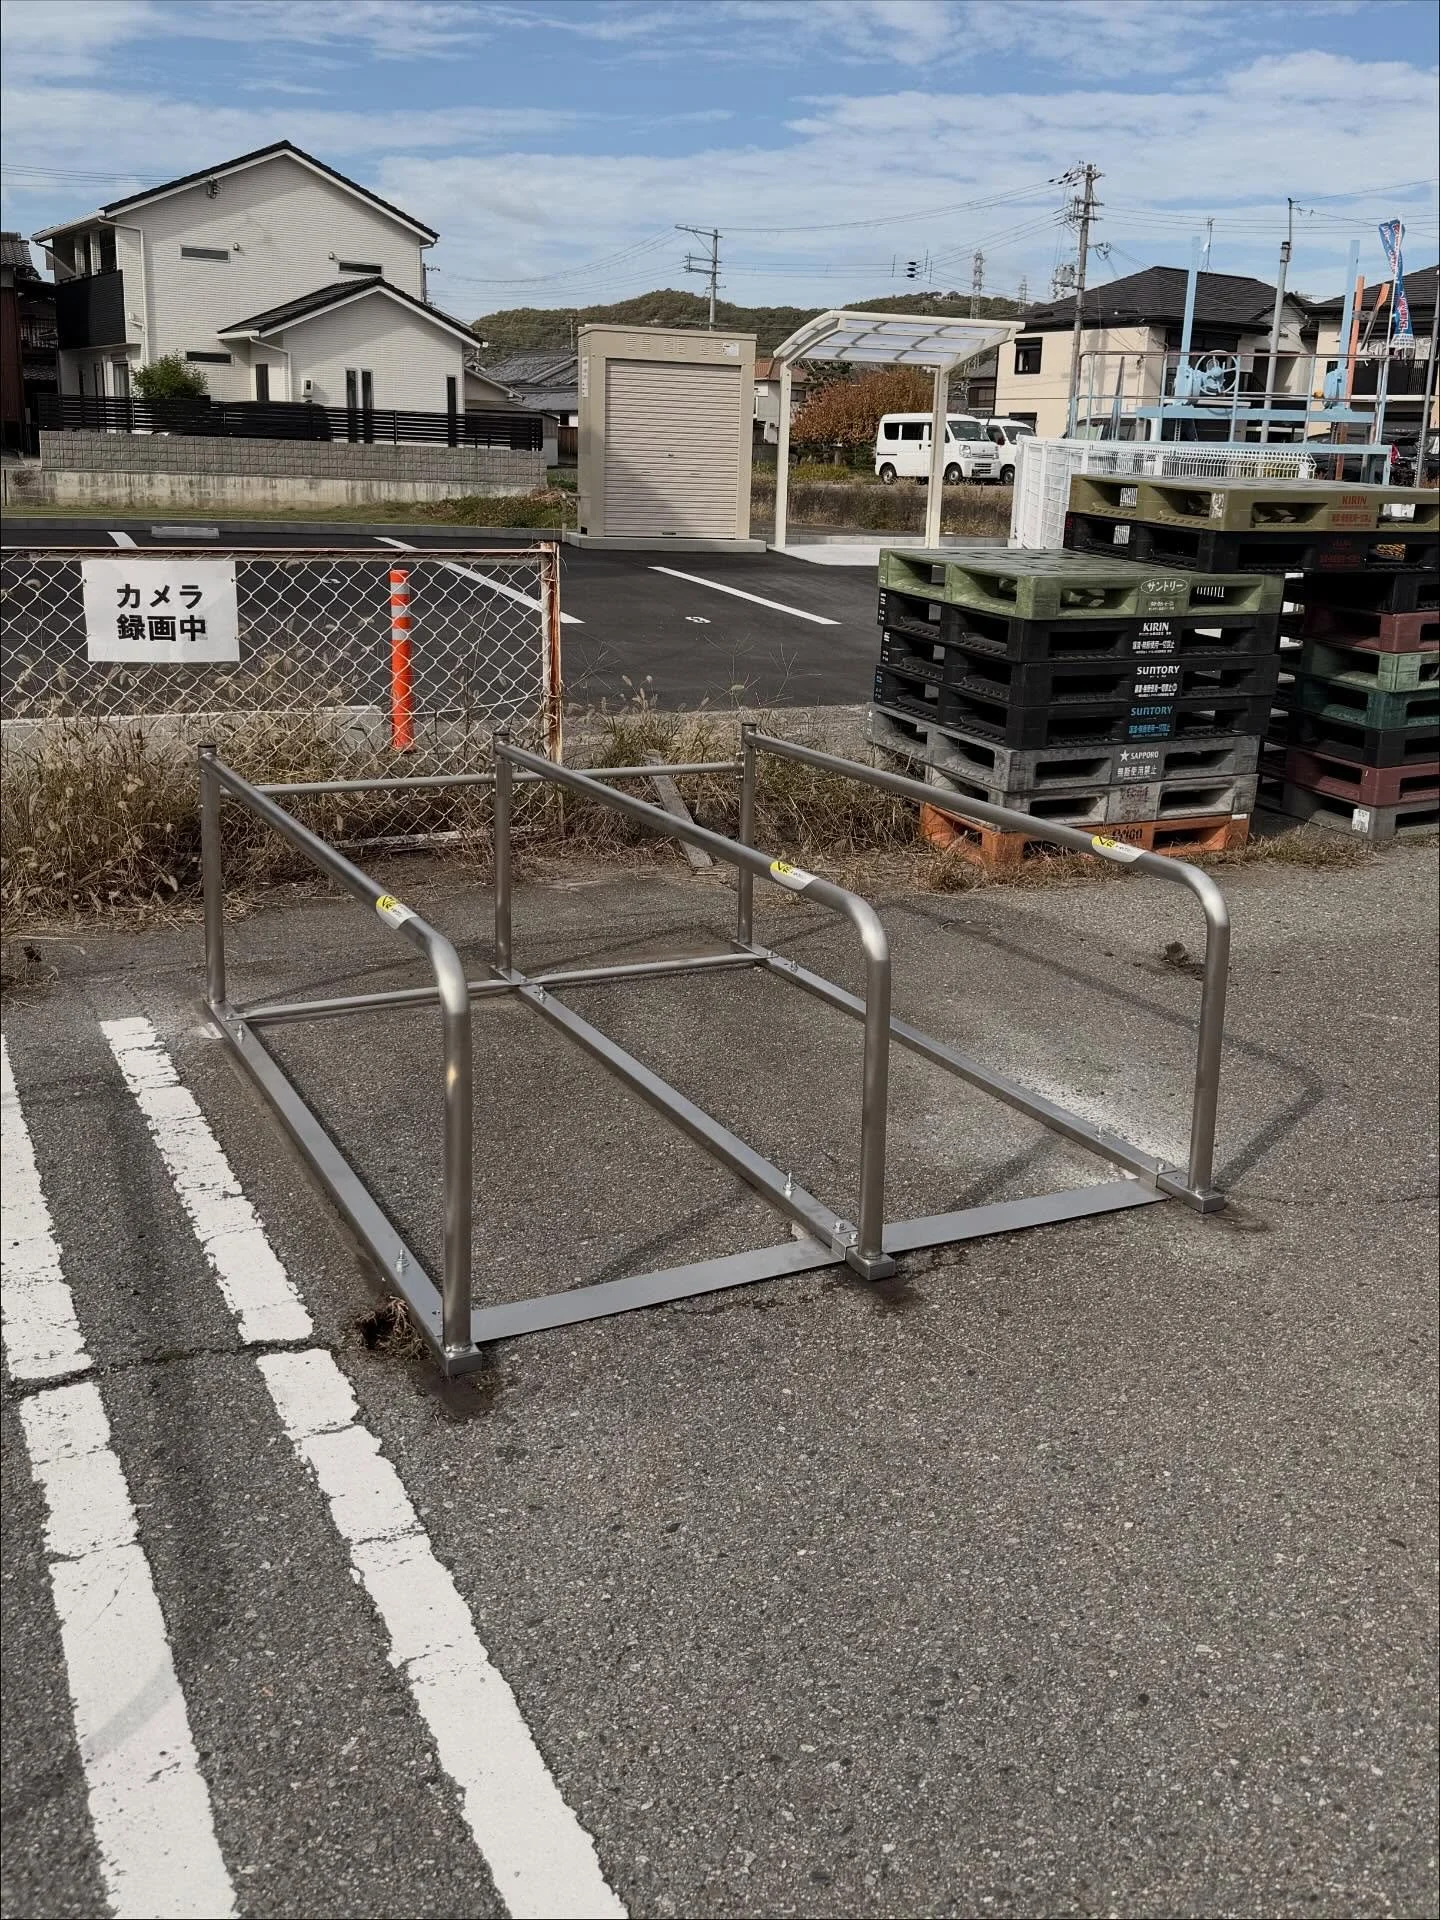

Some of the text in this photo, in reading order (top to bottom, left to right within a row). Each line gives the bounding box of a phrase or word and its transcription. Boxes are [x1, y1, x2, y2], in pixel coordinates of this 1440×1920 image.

[1342, 495, 1367, 505] KIRIN
[1147, 580, 1183, 592] サントリー
[116, 583, 203, 610] カメラ
[116, 613, 207, 642] 録画中
[1143, 621, 1169, 632] KIRIN
[1136, 665, 1180, 675] SUNTORY
[1130, 705, 1173, 716] SUNTORY
[1130, 751, 1159, 760] SAPPORO
